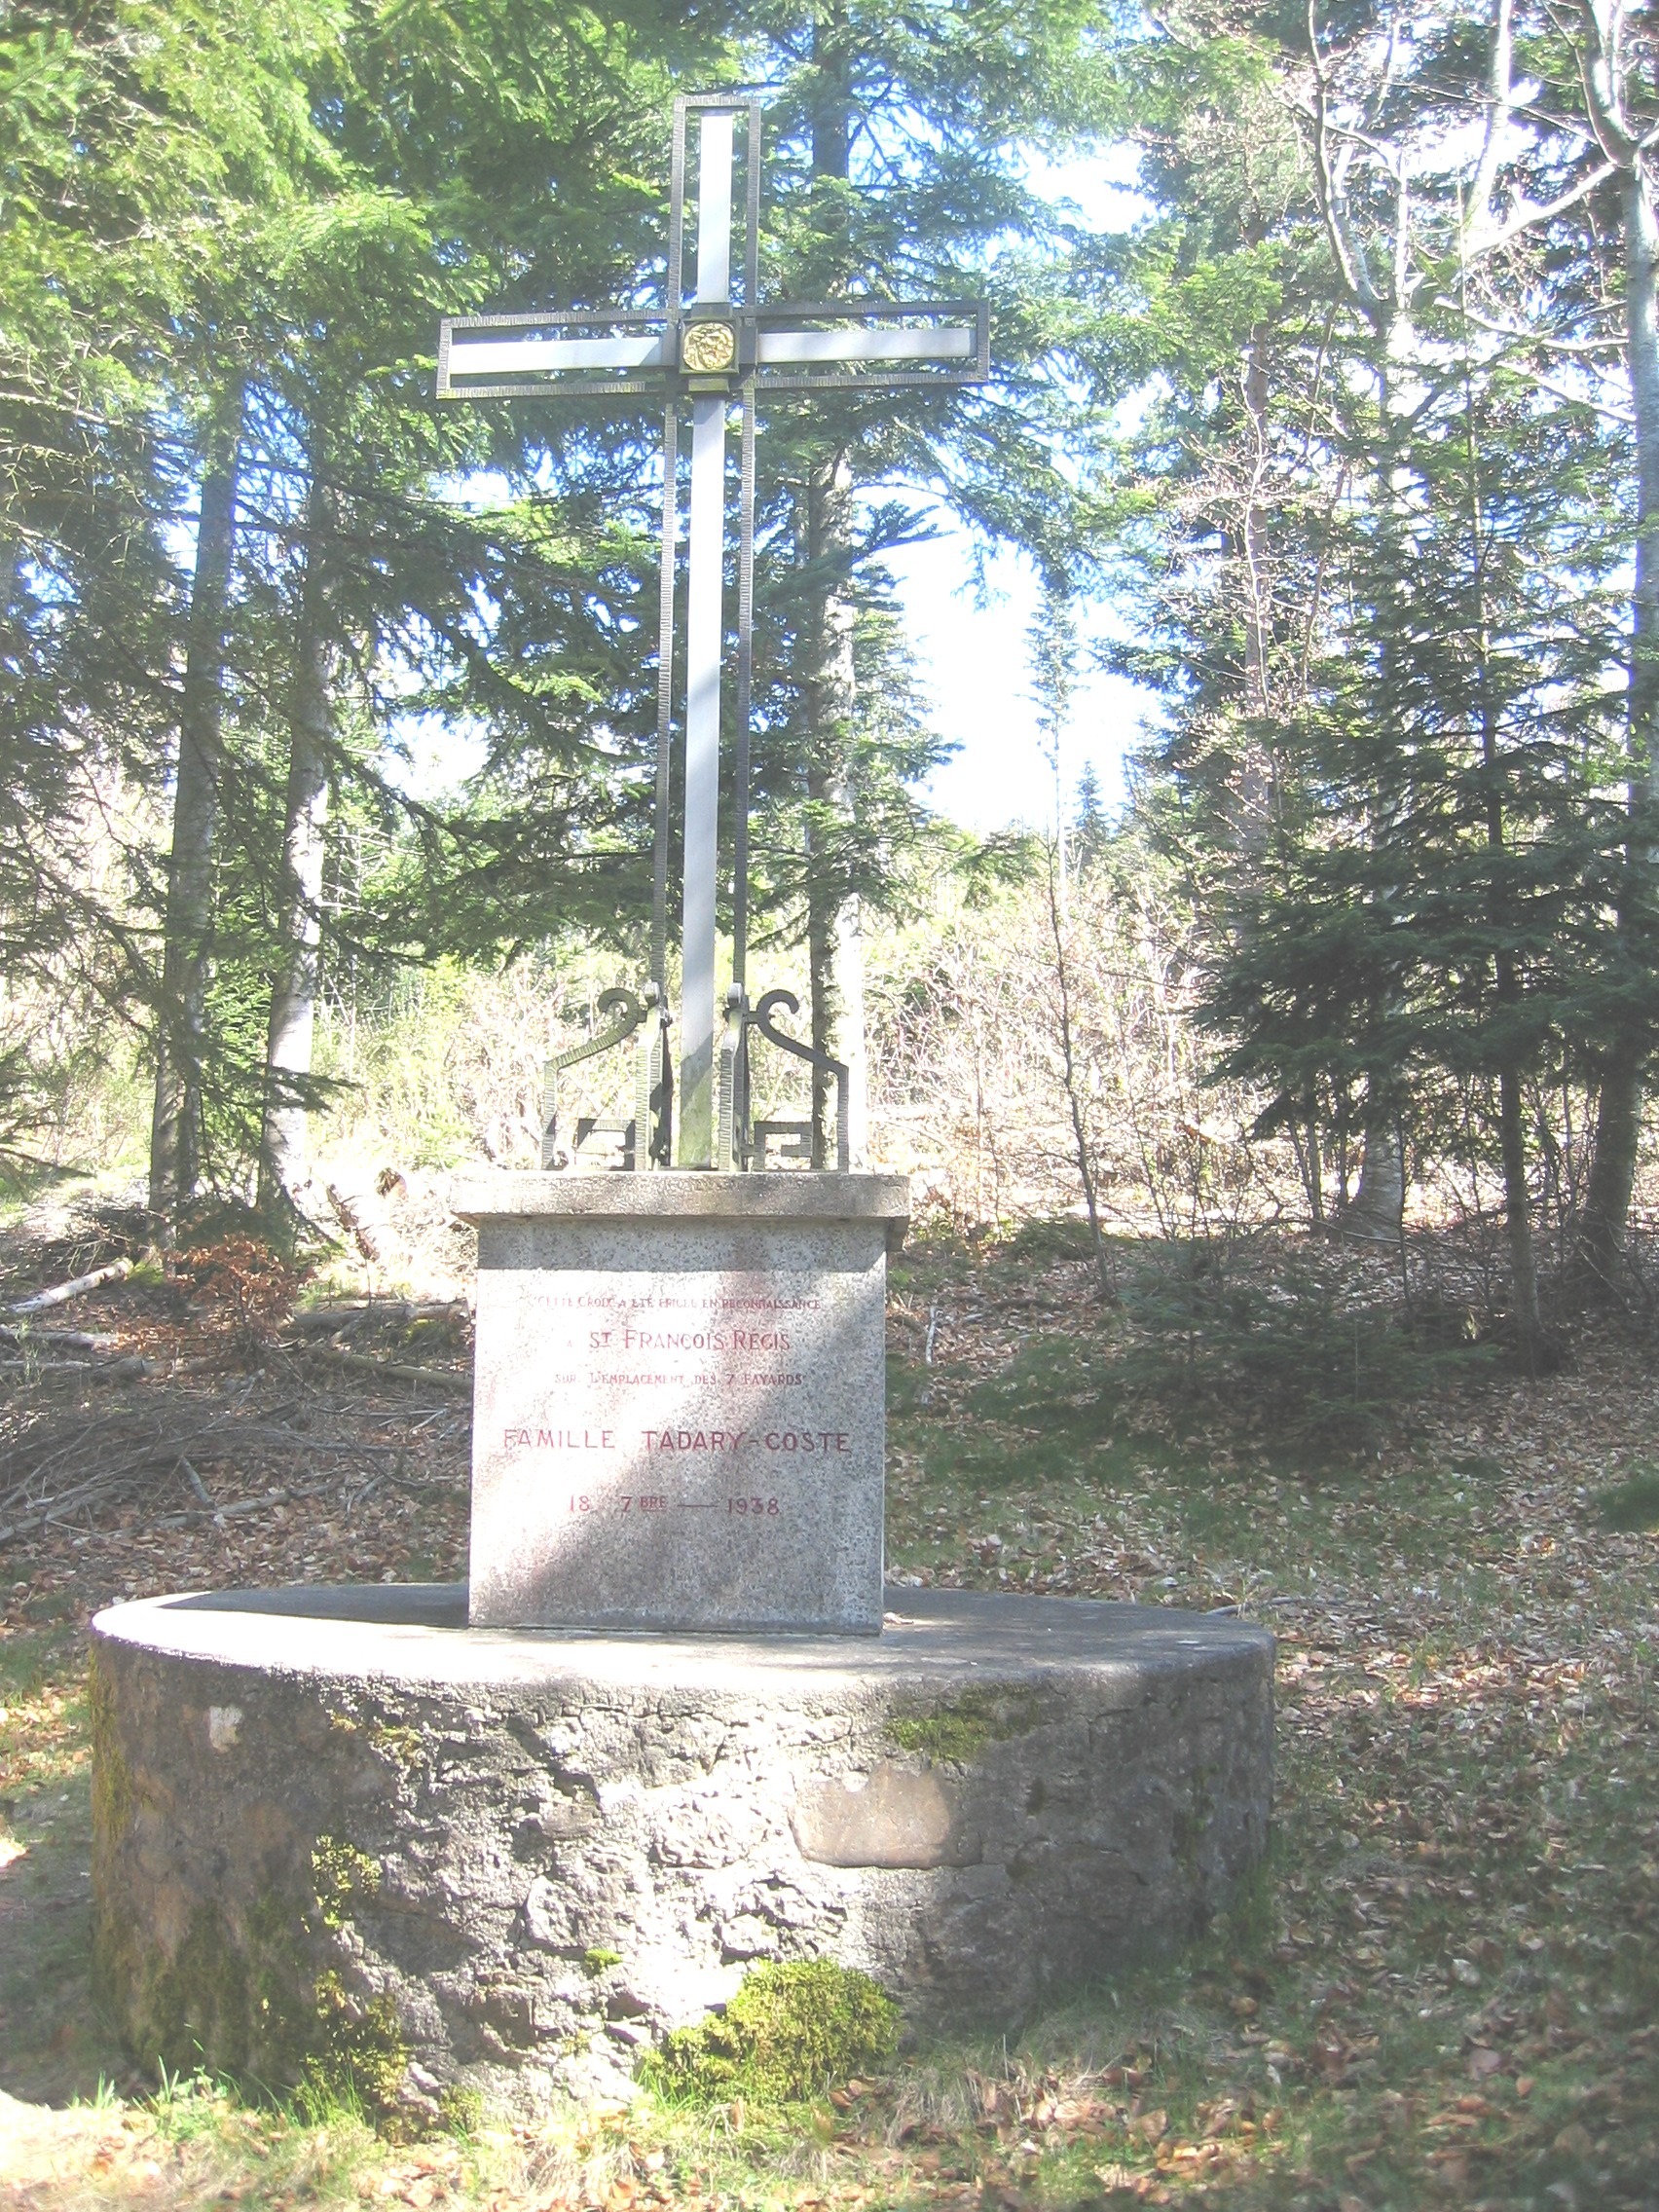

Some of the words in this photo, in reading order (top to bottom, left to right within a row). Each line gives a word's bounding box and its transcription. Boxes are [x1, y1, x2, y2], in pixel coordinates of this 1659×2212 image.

[702, 1299, 718, 1309] EN
[554, 1374, 576, 1384] SUR
[694, 1374, 717, 1385] DES
[726, 1374, 736, 1385] 7
[503, 1429, 616, 1449] FAMILLE
[569, 1495, 591, 1512] 18
[727, 1496, 780, 1516] 1938
